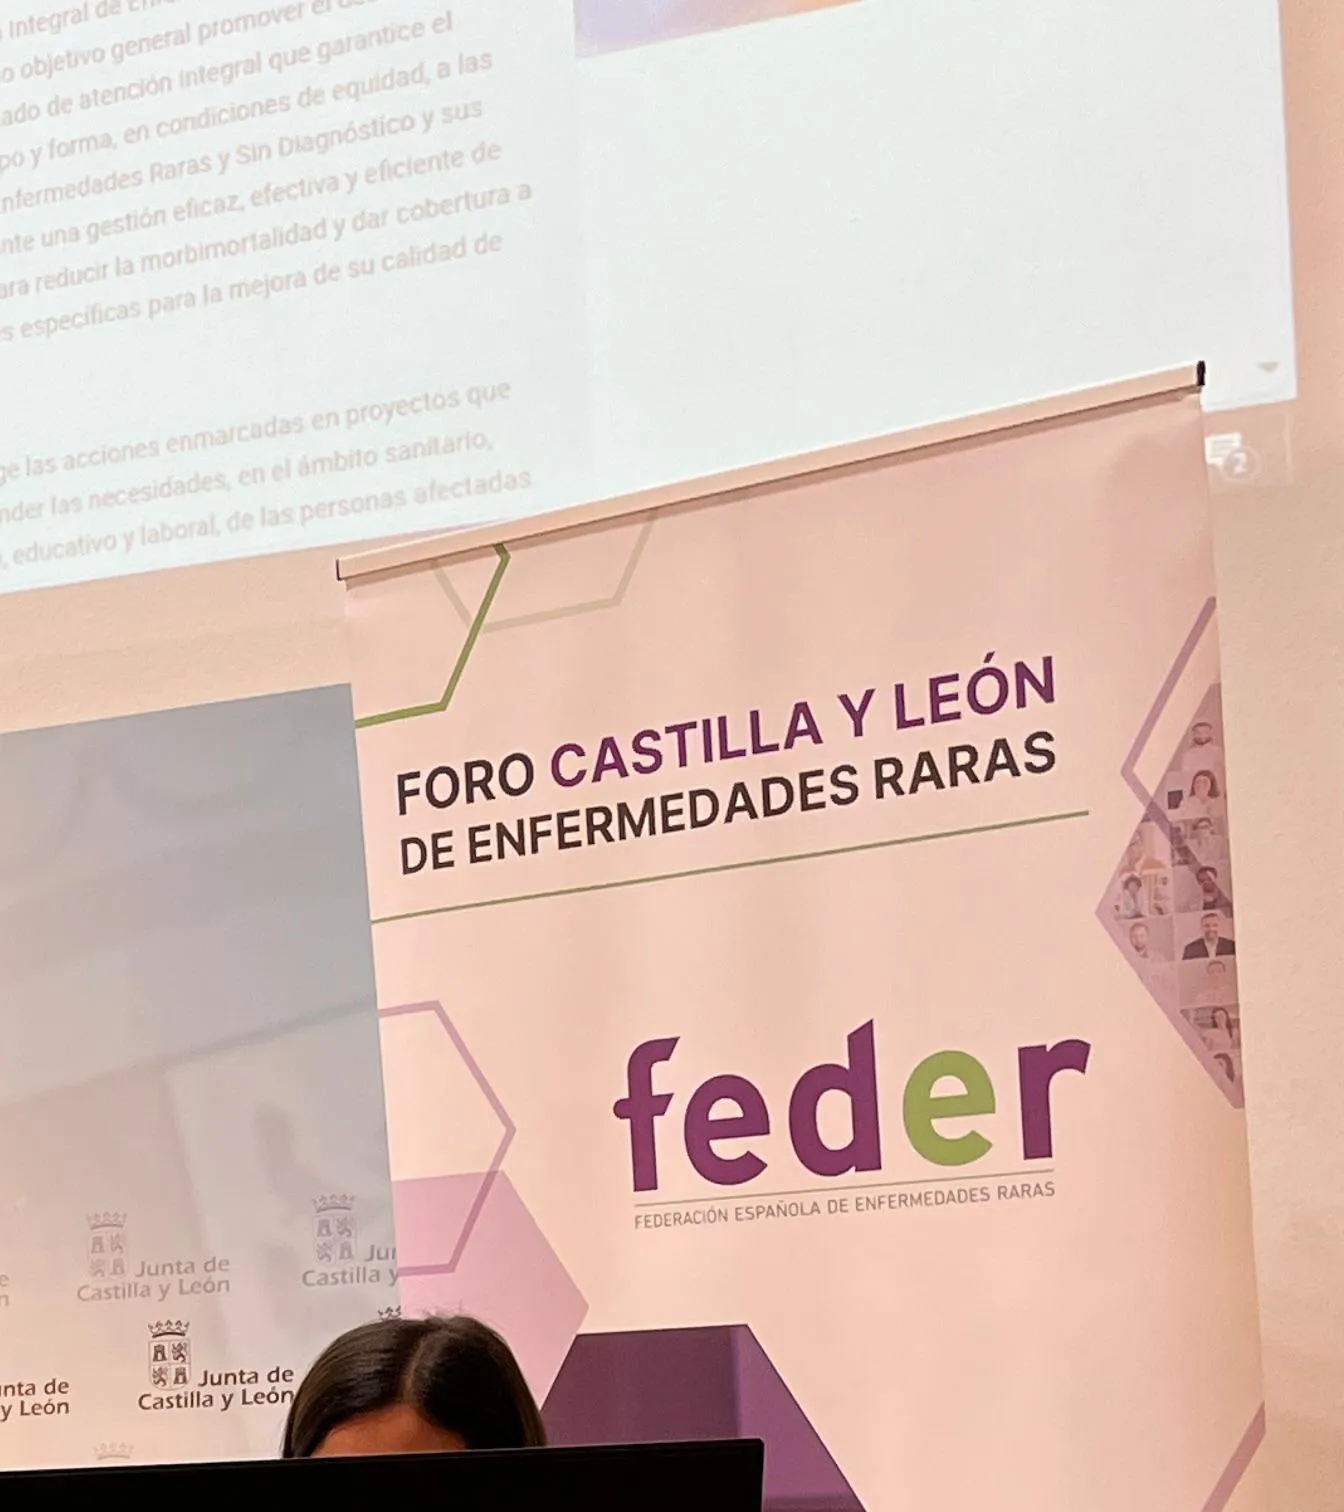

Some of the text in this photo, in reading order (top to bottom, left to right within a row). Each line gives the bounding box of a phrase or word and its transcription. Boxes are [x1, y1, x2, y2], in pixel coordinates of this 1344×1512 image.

[397, 652, 1055, 816] FORO CASTILLA Y LEÓN
[401, 730, 1055, 876] DE ENFERMEDADES RARAS
[613, 1018, 1091, 1192] feder
[635, 1181, 1055, 1229] FEDERACIÓN ESPAÑOLA DE ENFERMEDADES RARAS
[44, 1378, 69, 1395] de
[198, 1366, 294, 1387] Junta de
[0, 1404, 12, 1423] y
[20, 1398, 69, 1417] León
[139, 1389, 295, 1412] Castilla y León
